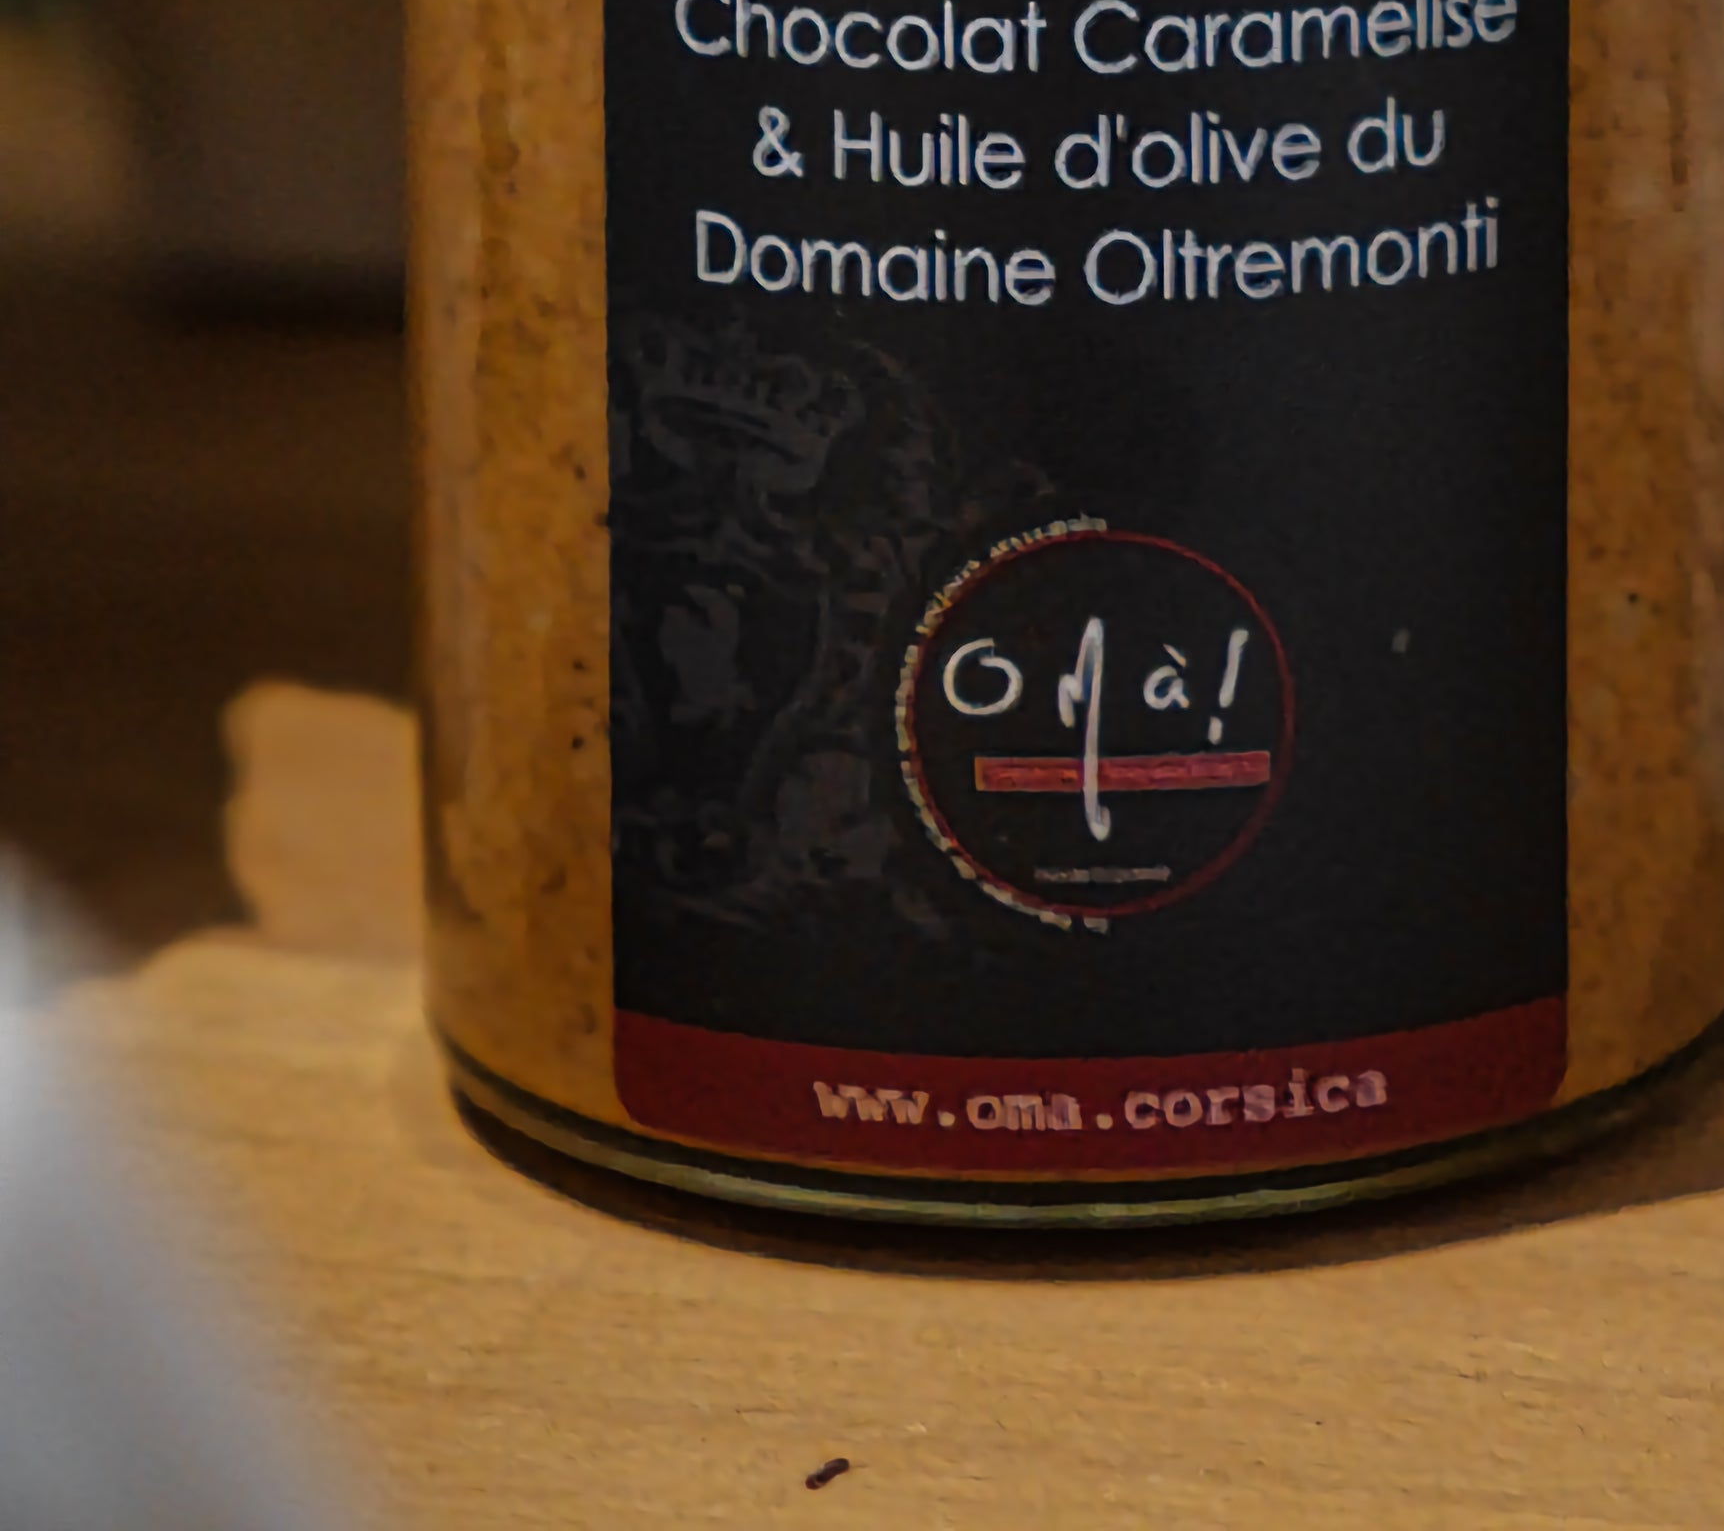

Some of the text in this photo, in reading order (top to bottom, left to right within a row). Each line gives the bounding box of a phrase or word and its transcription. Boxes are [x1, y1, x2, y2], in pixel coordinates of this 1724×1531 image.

[751, 96, 1445, 190] & Huile d'olive du
[695, 197, 1498, 306] Domaine Oltremonti
[813, 1068, 1388, 1131] www.oma.corsica
